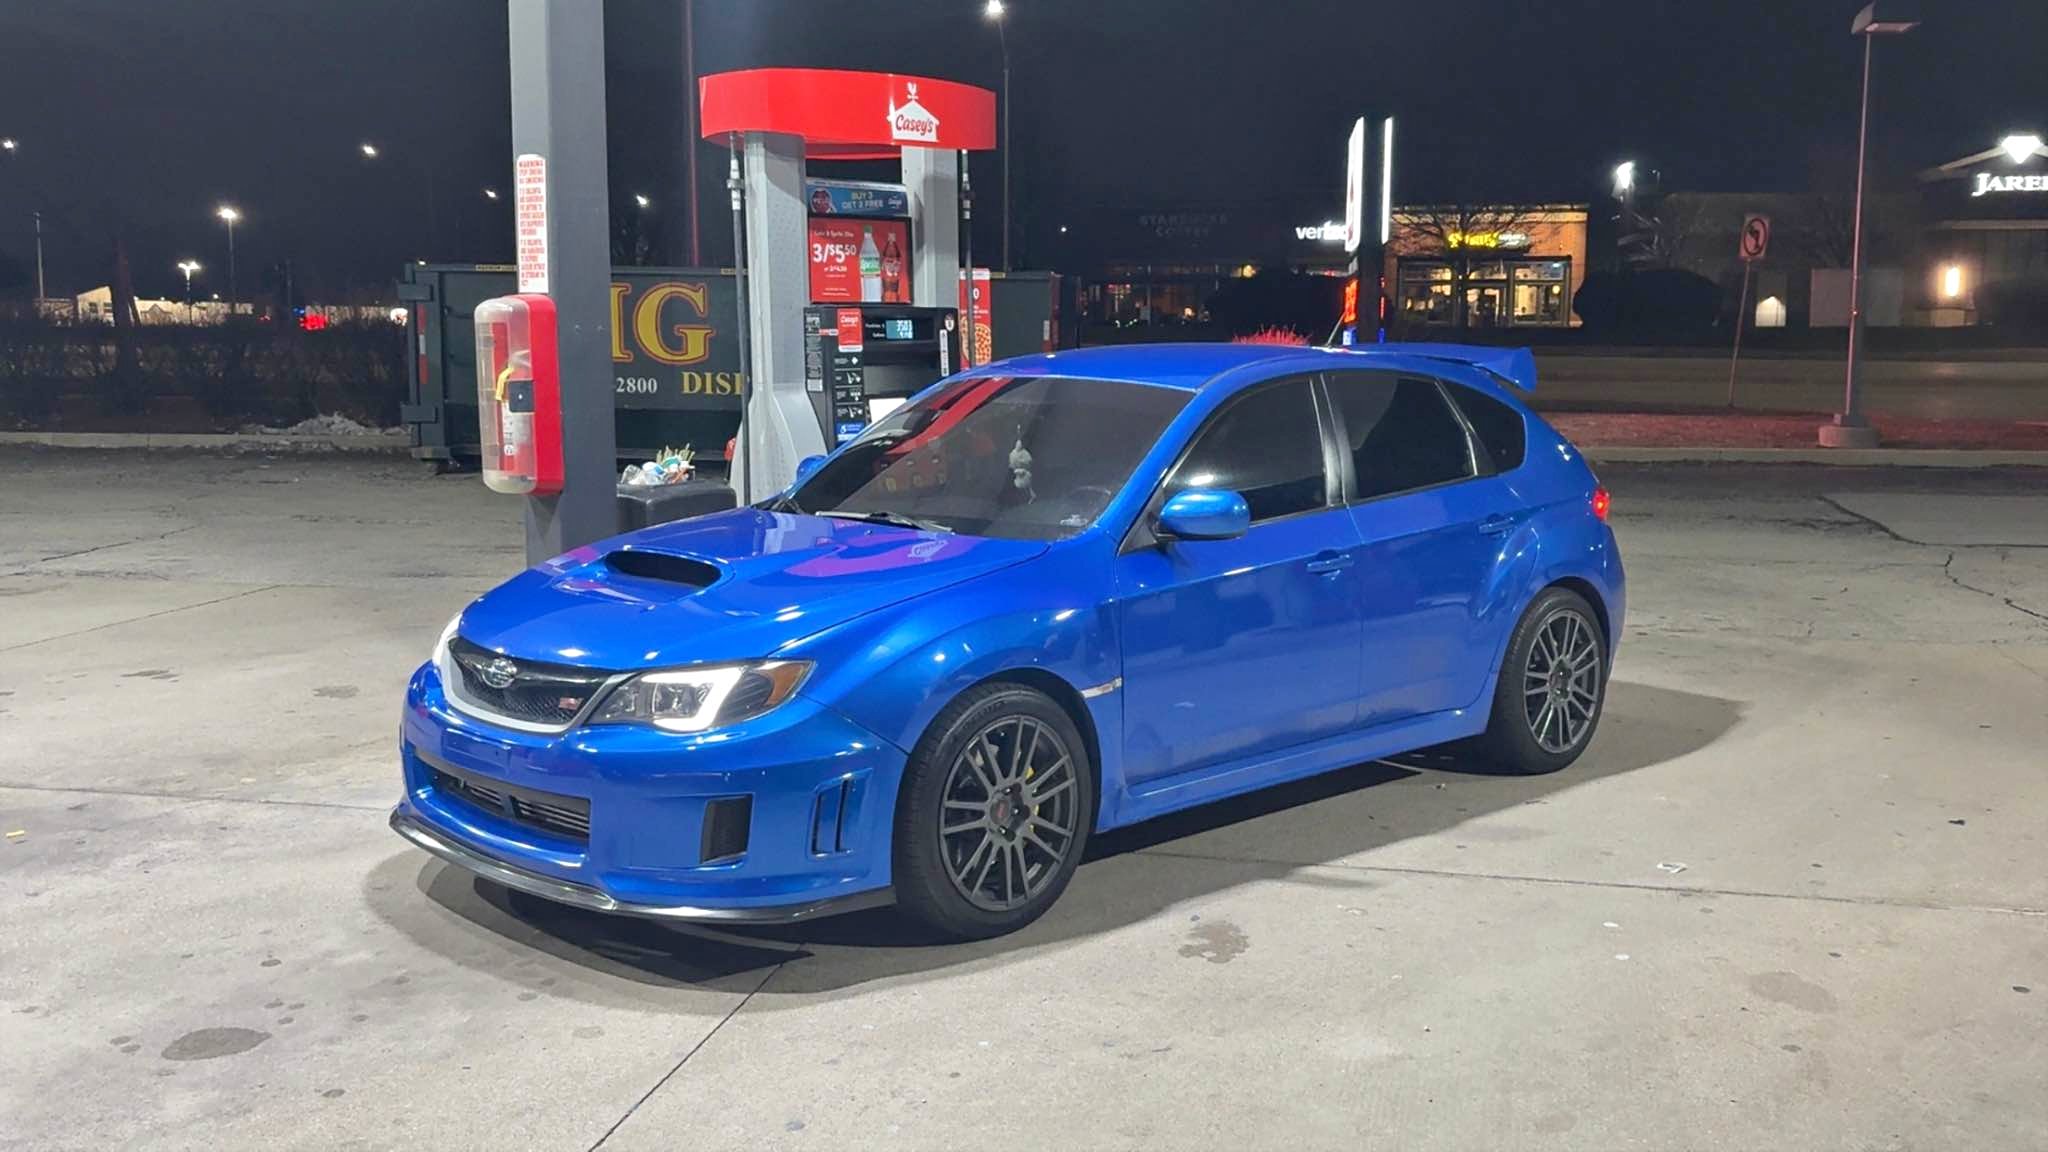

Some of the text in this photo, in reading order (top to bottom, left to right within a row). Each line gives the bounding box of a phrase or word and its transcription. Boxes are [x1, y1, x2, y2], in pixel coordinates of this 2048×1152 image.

[896, 114, 934, 136] Casey's
[1295, 220, 1347, 241] veri
[615, 377, 658, 393] 2800
